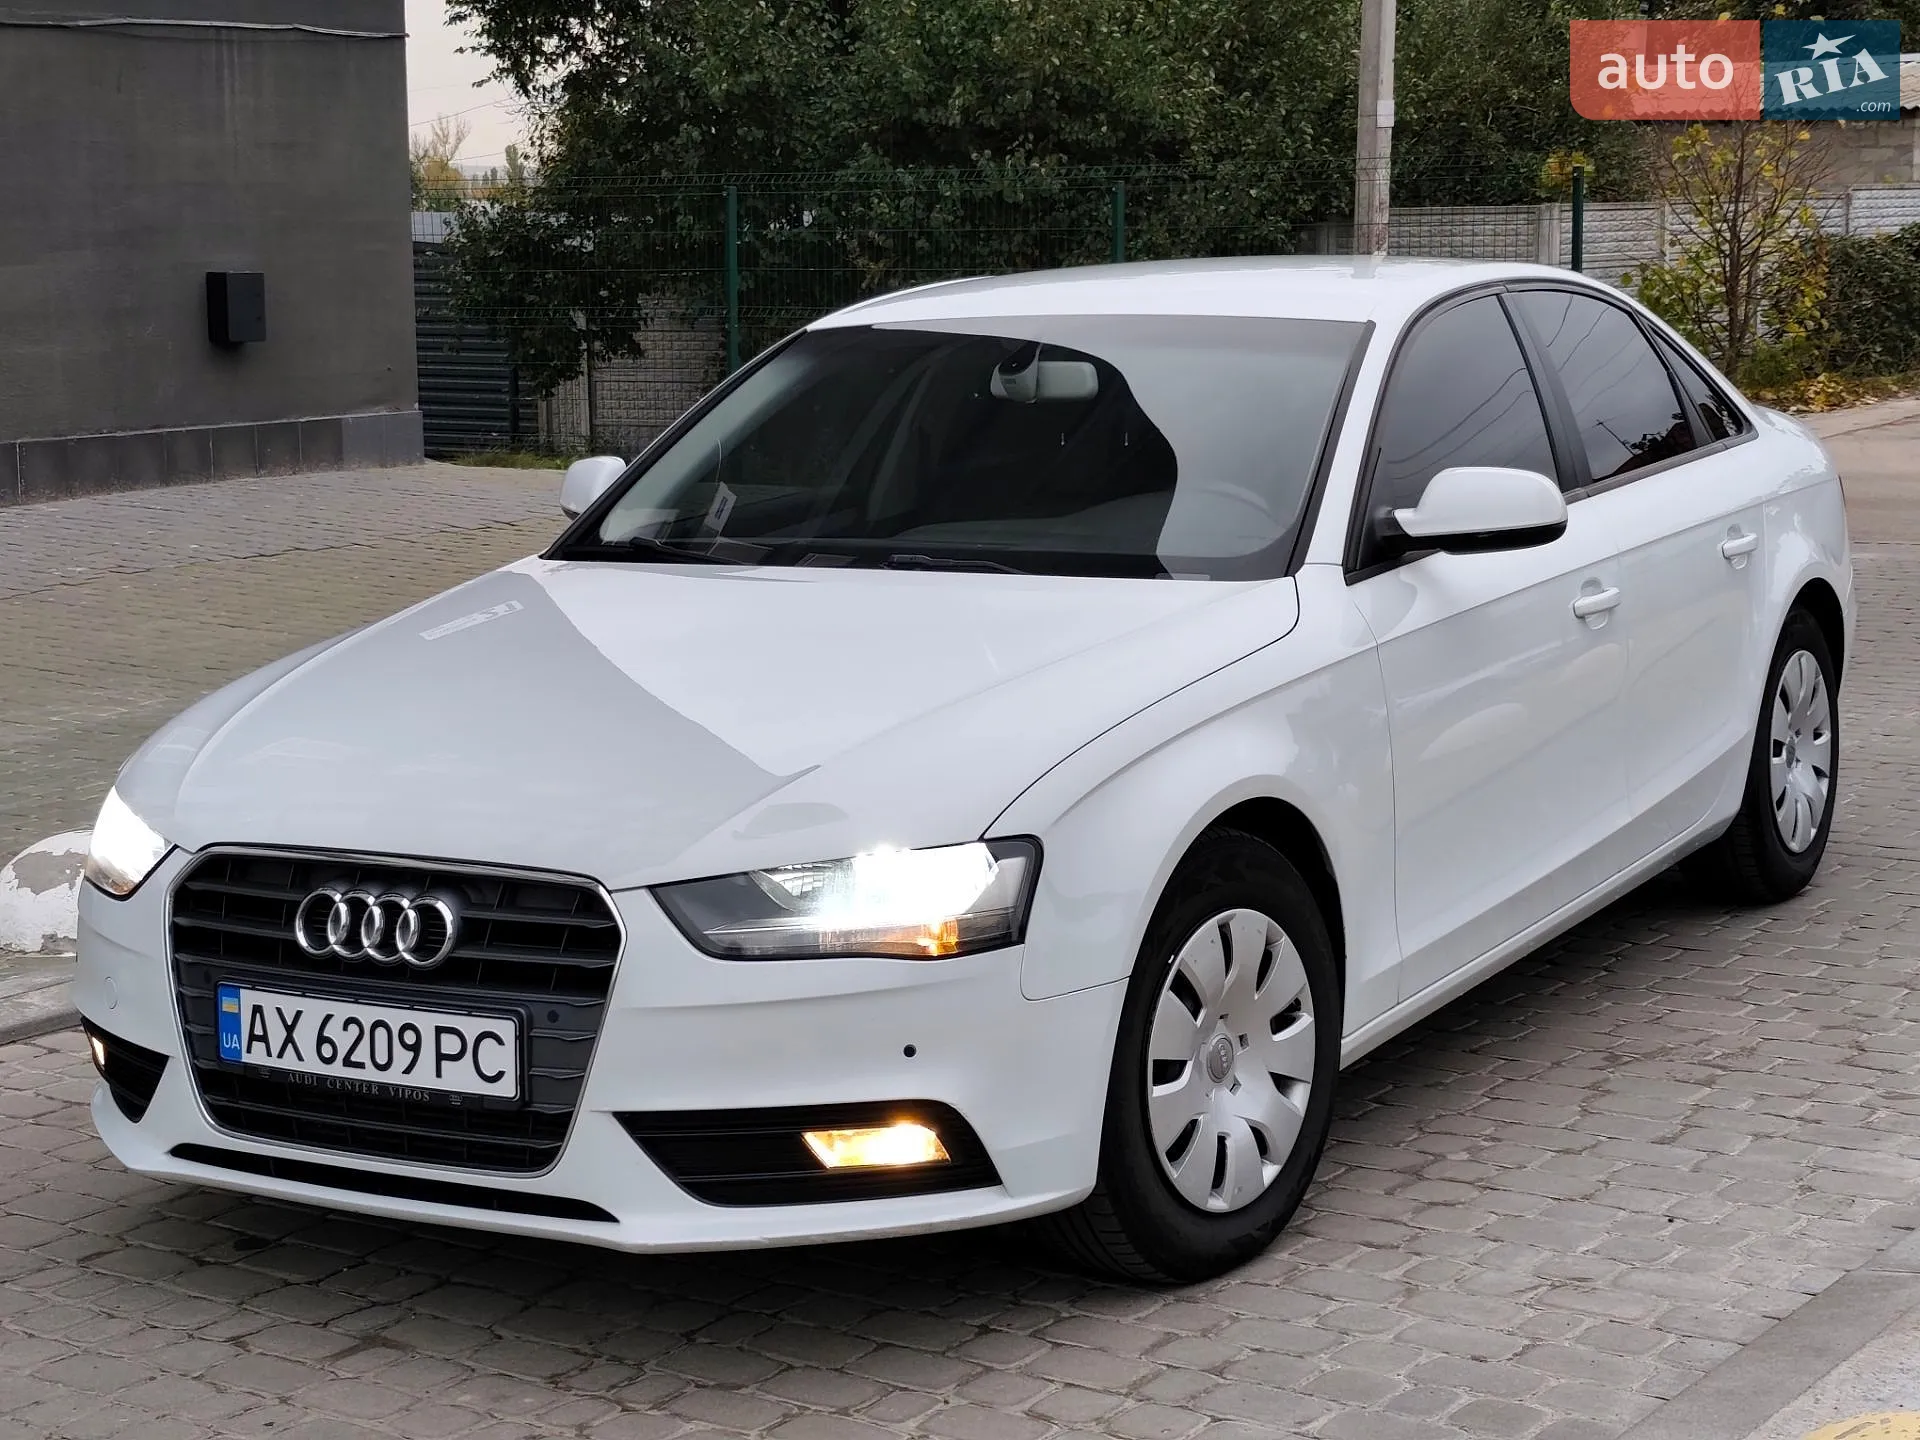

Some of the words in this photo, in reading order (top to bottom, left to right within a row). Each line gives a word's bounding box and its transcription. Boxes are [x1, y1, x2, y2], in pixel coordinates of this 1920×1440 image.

[223, 1032, 240, 1050] UA
[246, 1004, 304, 1062] AX
[315, 1013, 422, 1075] 6209
[435, 1025, 506, 1084] PC
[287, 1072, 318, 1087] AUDI
[327, 1078, 379, 1095] CENTER
[388, 1086, 430, 1101] VIPOS
